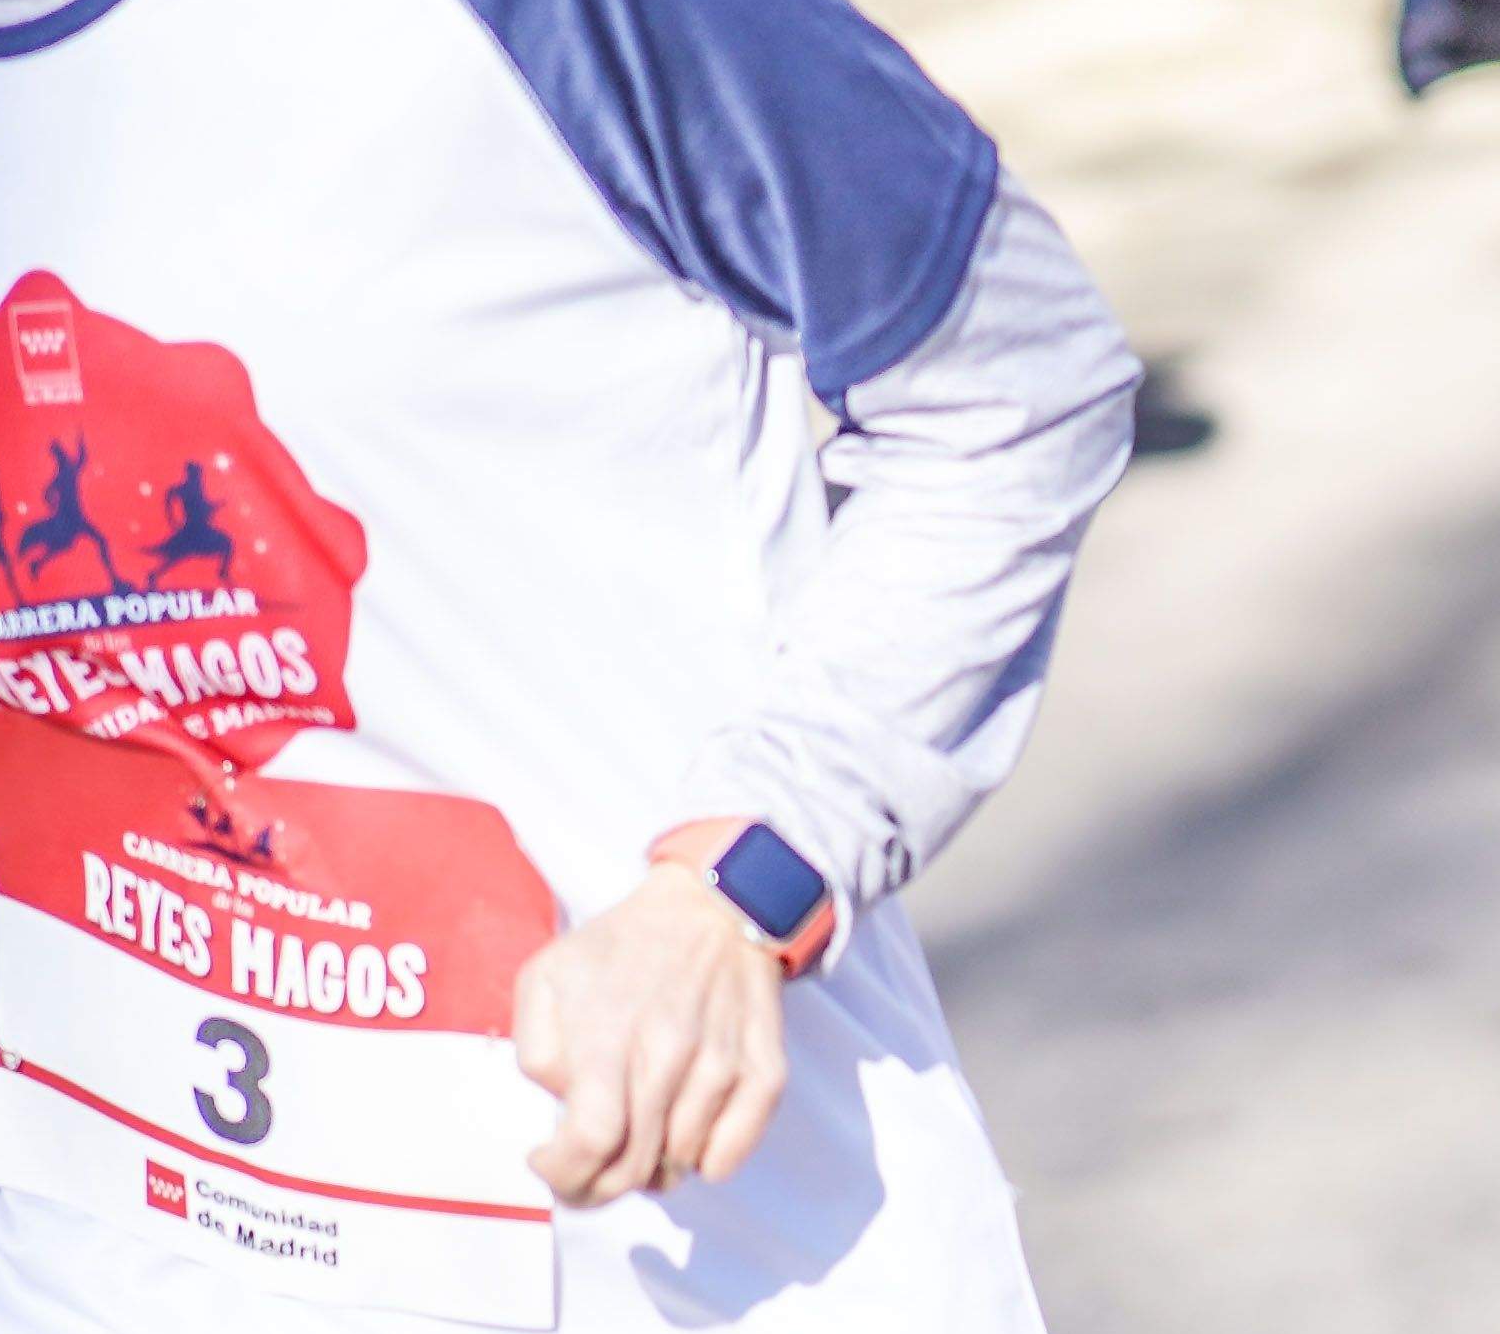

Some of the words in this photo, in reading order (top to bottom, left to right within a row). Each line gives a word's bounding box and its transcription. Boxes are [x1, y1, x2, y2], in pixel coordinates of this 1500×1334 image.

[103, 588, 260, 626] POPULAR
[117, 625, 318, 708] MAGOS
[122, 830, 234, 891] CARRERA
[235, 869, 373, 931] POPULAR
[82, 850, 213, 978] REYES
[230, 917, 427, 1019] MAGOS
[193, 1017, 273, 1146] 3
[195, 1178, 339, 1238] Comunidad
[198, 1209, 226, 1237] de
[236, 1222, 339, 1268] Madrid
